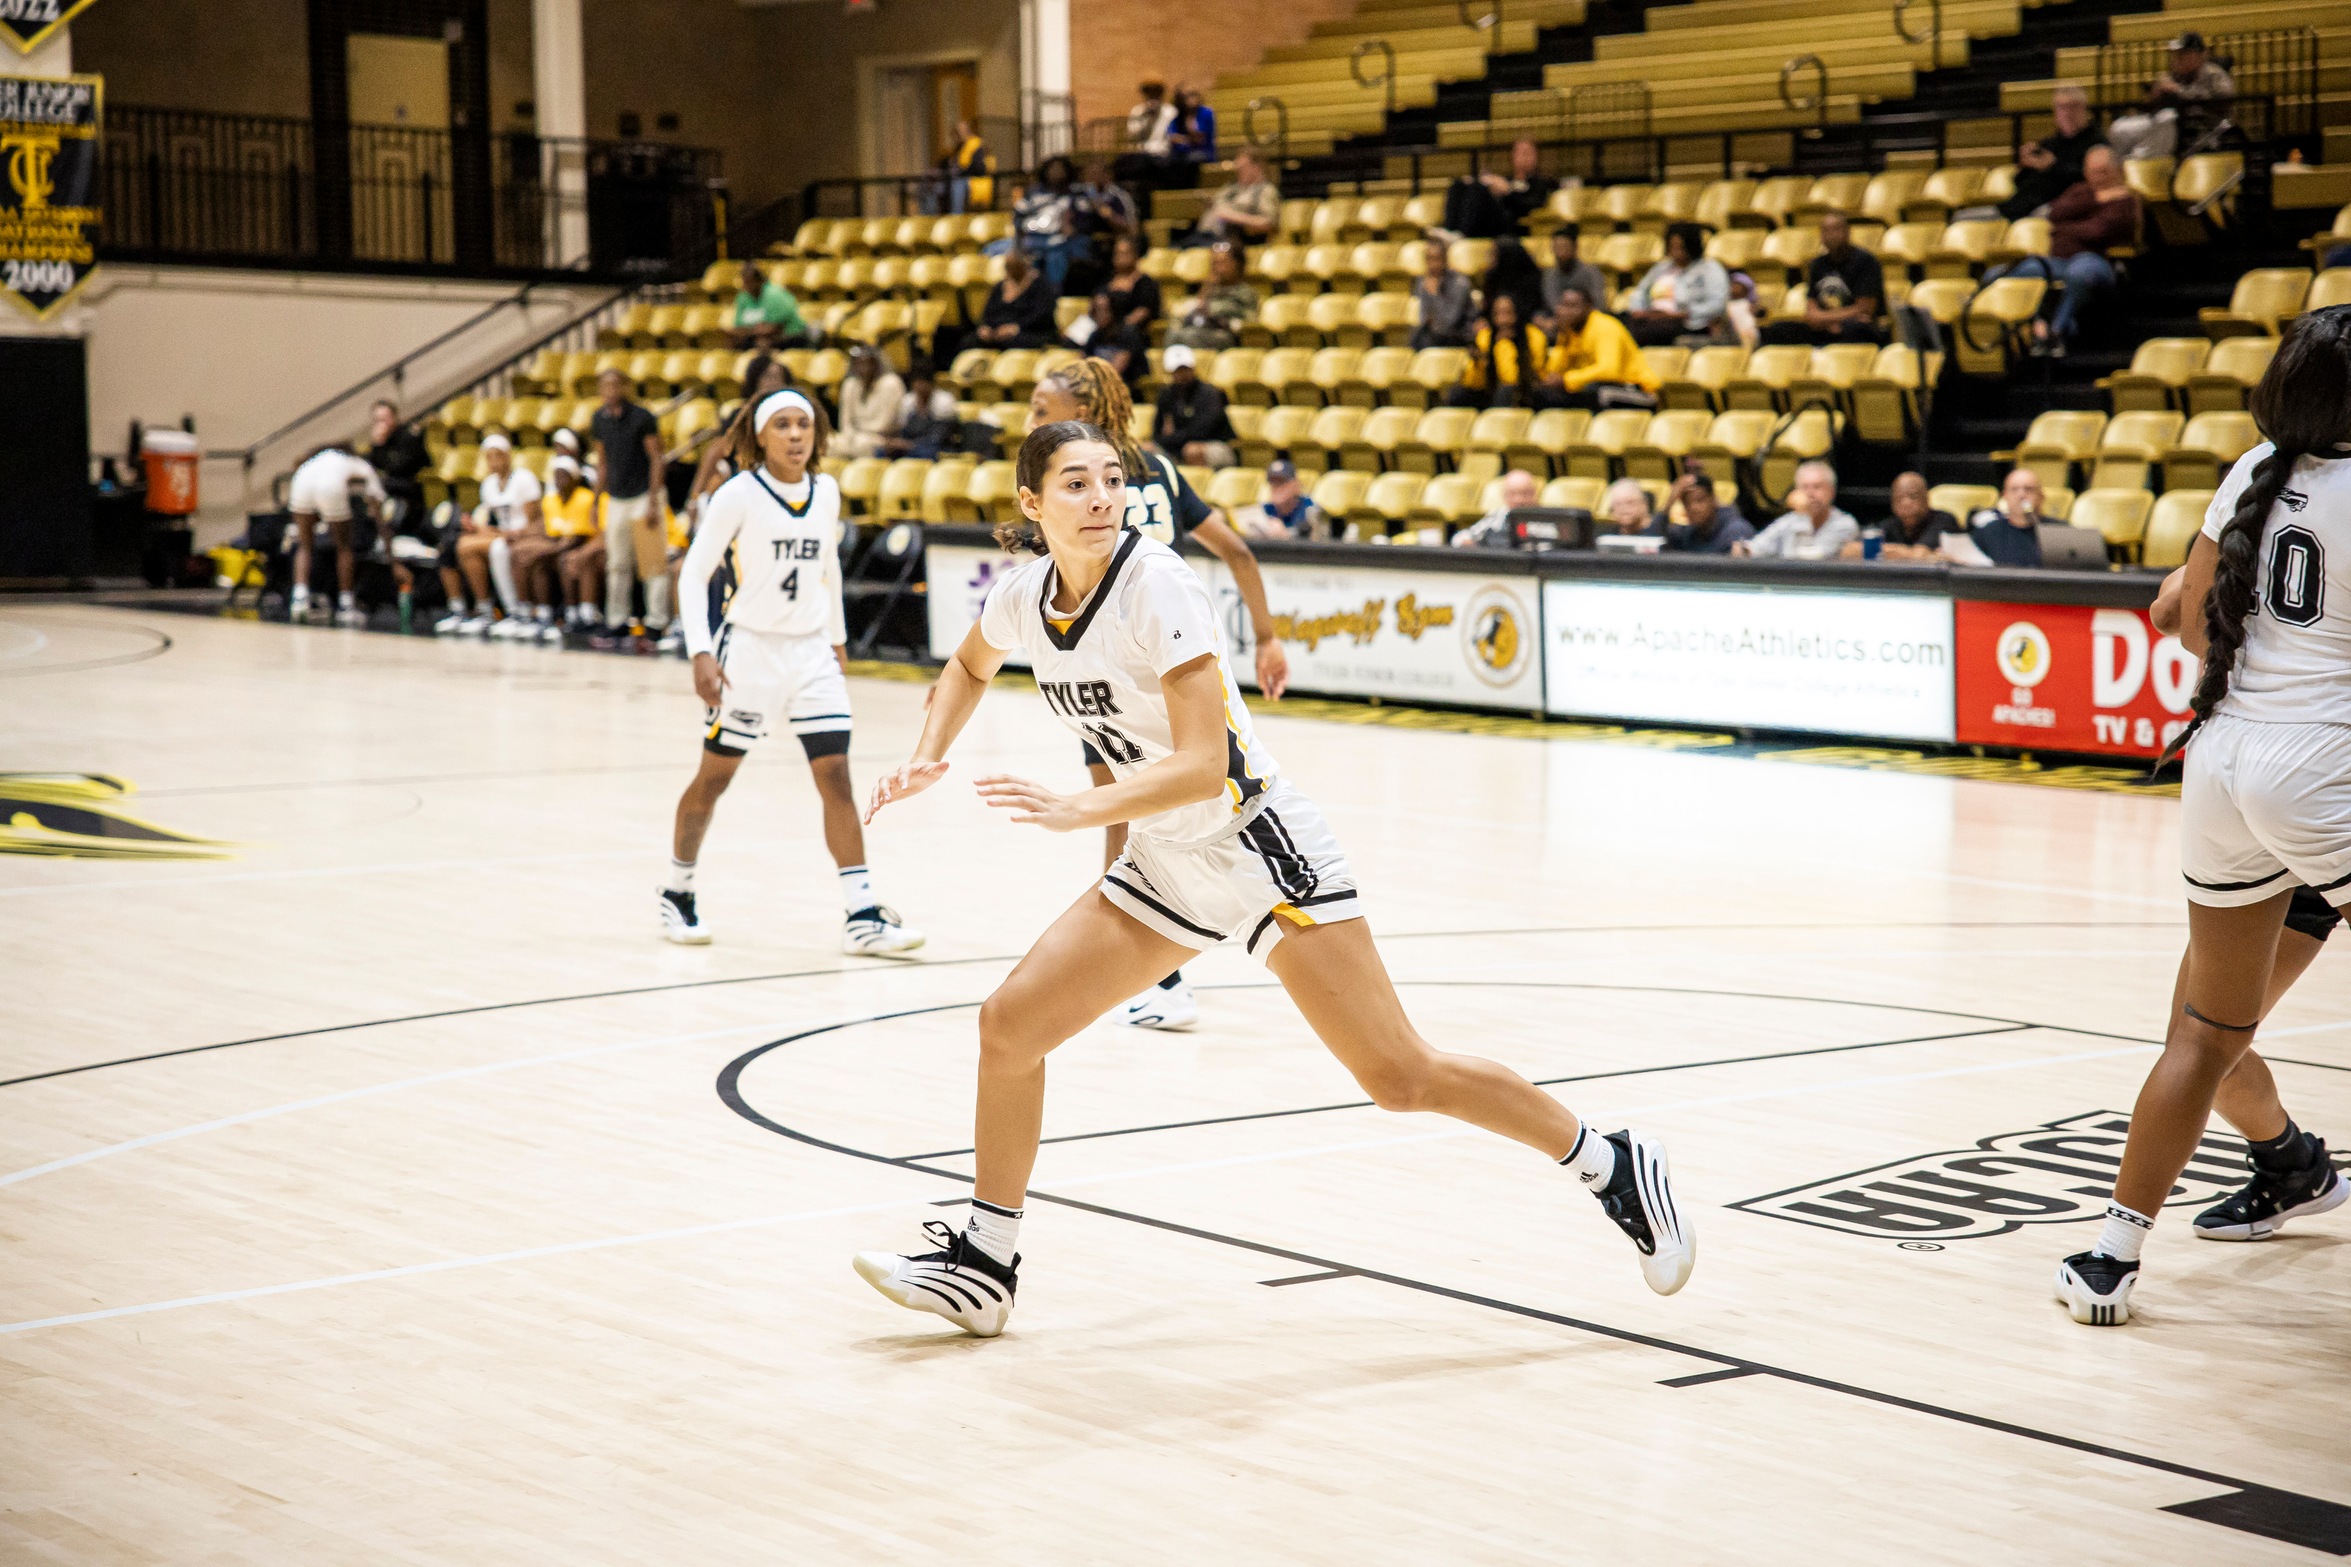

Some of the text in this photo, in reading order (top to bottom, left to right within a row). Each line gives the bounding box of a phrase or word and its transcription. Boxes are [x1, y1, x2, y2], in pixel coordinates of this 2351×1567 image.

[3, 259, 75, 292] 2000
[772, 538, 820, 560] TYLER
[781, 567, 799, 601] 4
[2248, 524, 2325, 627] 0
[1556, 621, 1945, 667] www.ApacheAthletics.com
[1038, 679, 1123, 718] TYLER
[1081, 722, 1146, 765] 11
[2092, 714, 2128, 745] TV
[2134, 716, 2155, 748] &
